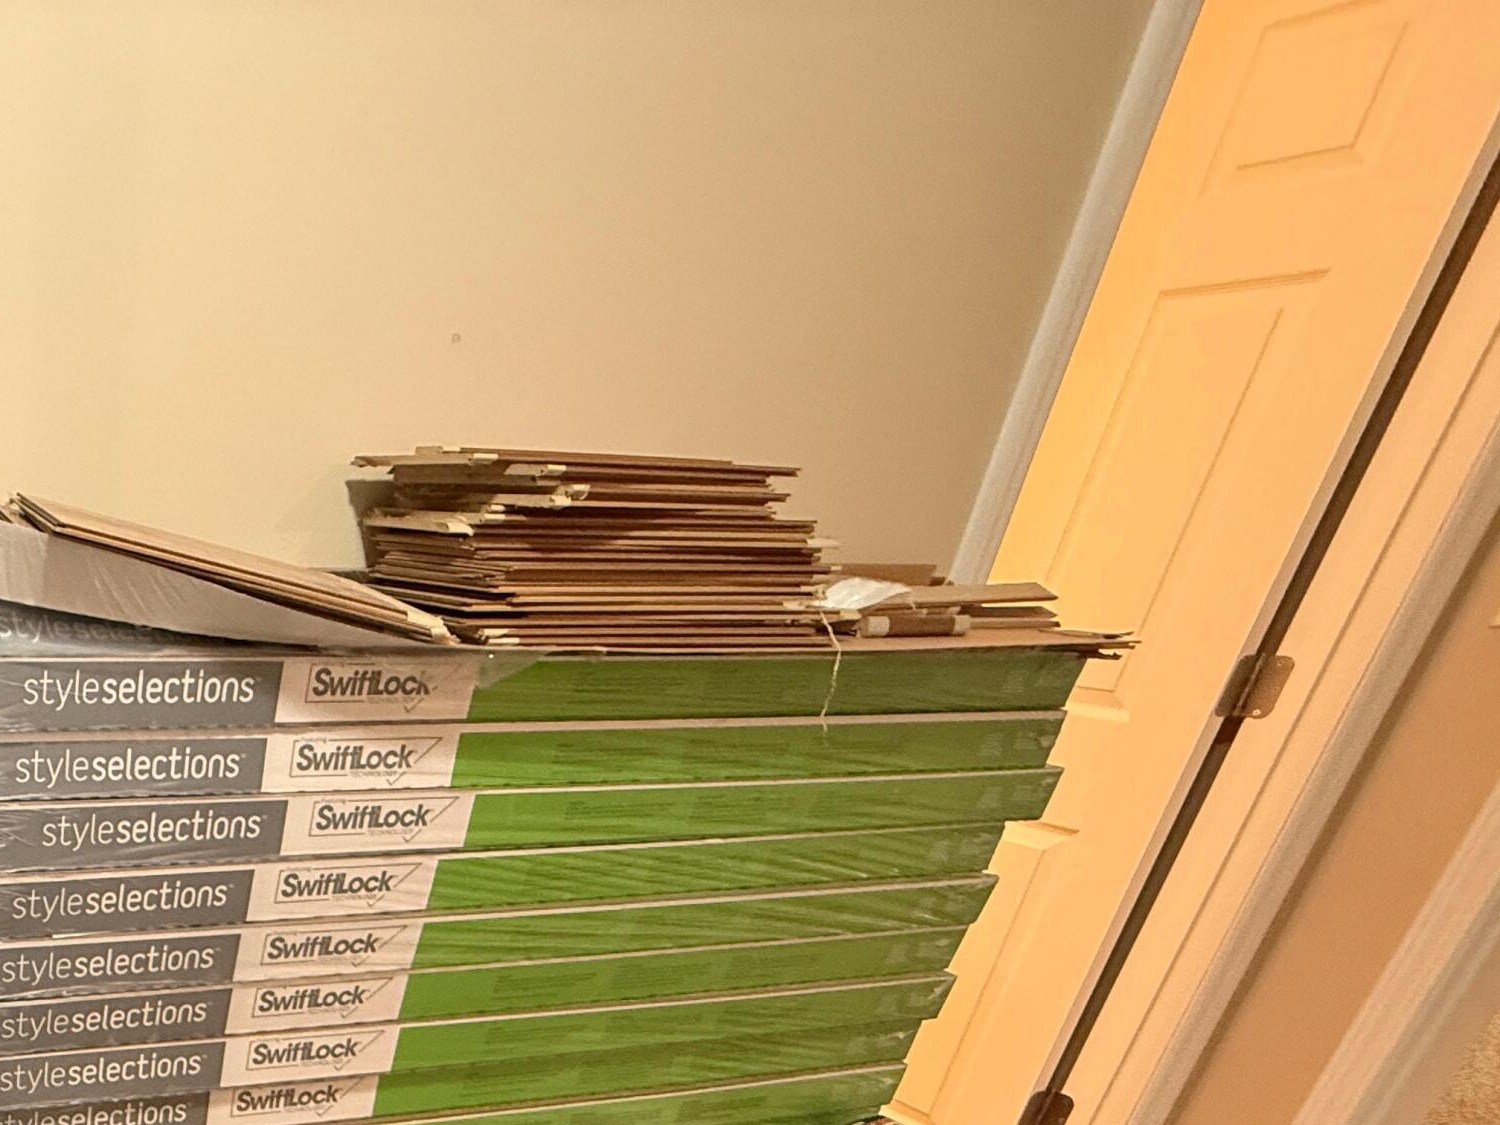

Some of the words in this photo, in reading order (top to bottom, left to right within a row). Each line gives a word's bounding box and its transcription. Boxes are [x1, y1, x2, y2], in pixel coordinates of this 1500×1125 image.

[23, 669, 254, 711] styleselections
[313, 663, 432, 696] SwiftLock
[16, 750, 240, 790] styleselections
[295, 743, 413, 774] SwiftLock
[43, 811, 261, 850] styleselections
[316, 803, 432, 832] SwiftLock
[12, 882, 226, 921] styleselections
[281, 871, 394, 902] SwiftLock
[267, 933, 380, 960] SwiftLock
[2, 945, 214, 986] styleselections
[258, 985, 365, 1013] SwiftLock
[2, 1001, 206, 1040] styleselections
[253, 1038, 359, 1066] SwiftLock
[0, 1052, 201, 1092] styleselections
[236, 1085, 340, 1112] SwiftLock
